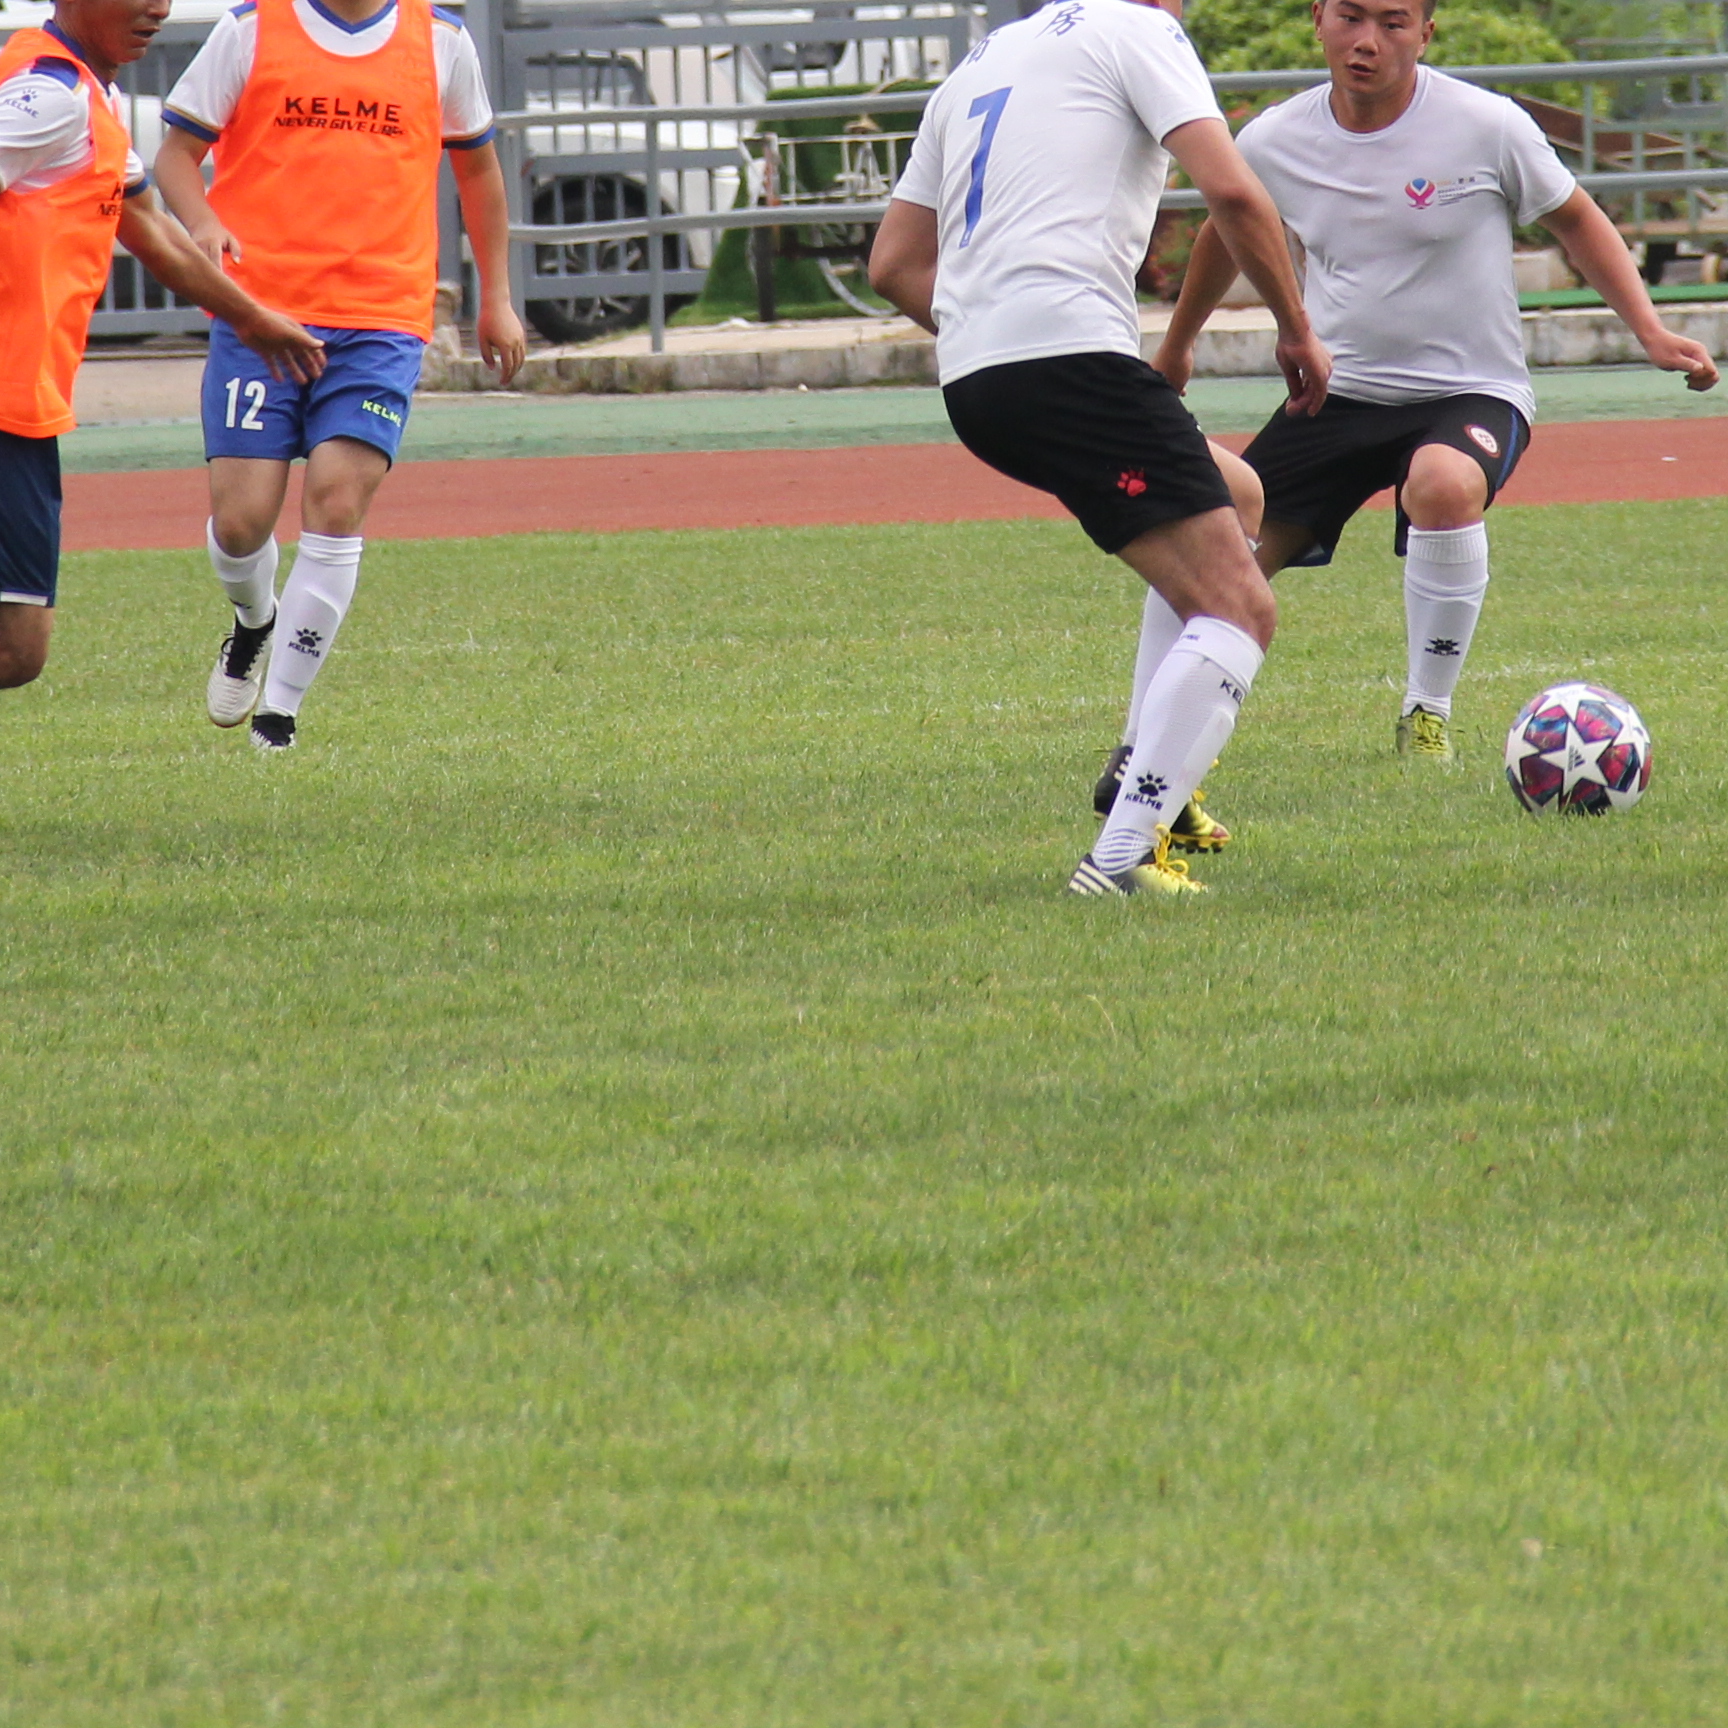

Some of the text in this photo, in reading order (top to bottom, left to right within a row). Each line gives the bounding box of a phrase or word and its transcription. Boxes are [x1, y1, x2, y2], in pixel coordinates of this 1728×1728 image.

[4, 98, 39, 119] KELME
[284, 96, 402, 123] KELME
[274, 116, 327, 129] NEVER
[329, 117, 367, 132] GIVE
[959, 85, 1014, 250] 7
[225, 377, 266, 431] 12
[1124, 791, 1164, 812] KELME
